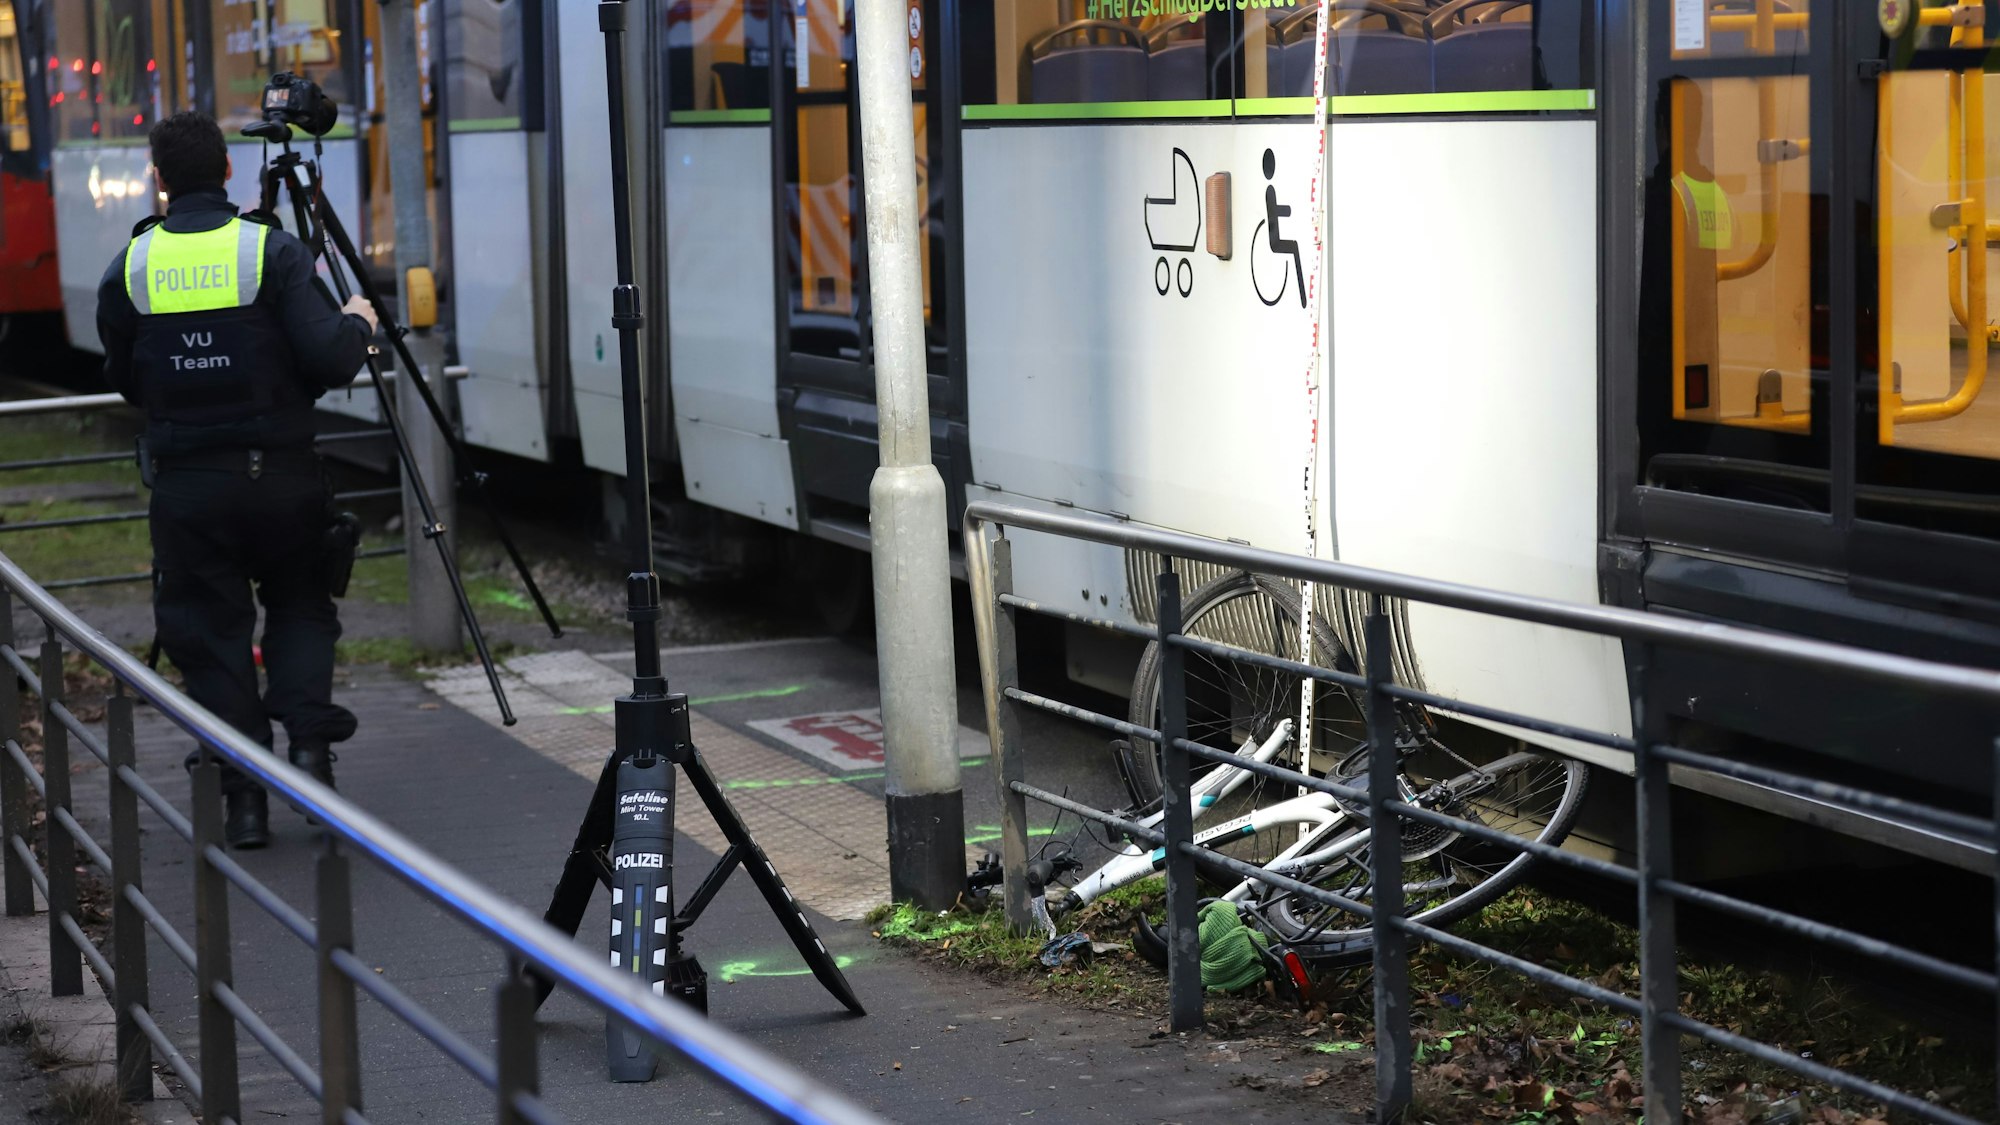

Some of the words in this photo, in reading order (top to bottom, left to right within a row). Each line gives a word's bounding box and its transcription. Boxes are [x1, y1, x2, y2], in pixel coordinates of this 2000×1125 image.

[1088, 0, 1295, 23] #Herzscage
[155, 264, 230, 293] POLIZEI
[181, 331, 213, 348] VU
[170, 355, 231, 371] Team
[620, 791, 668, 805] Safeline
[620, 804, 636, 814] Mini
[638, 804, 665, 813] Tower
[1194, 815, 1252, 841] PEGASU
[615, 852, 663, 871] POLIZEI
